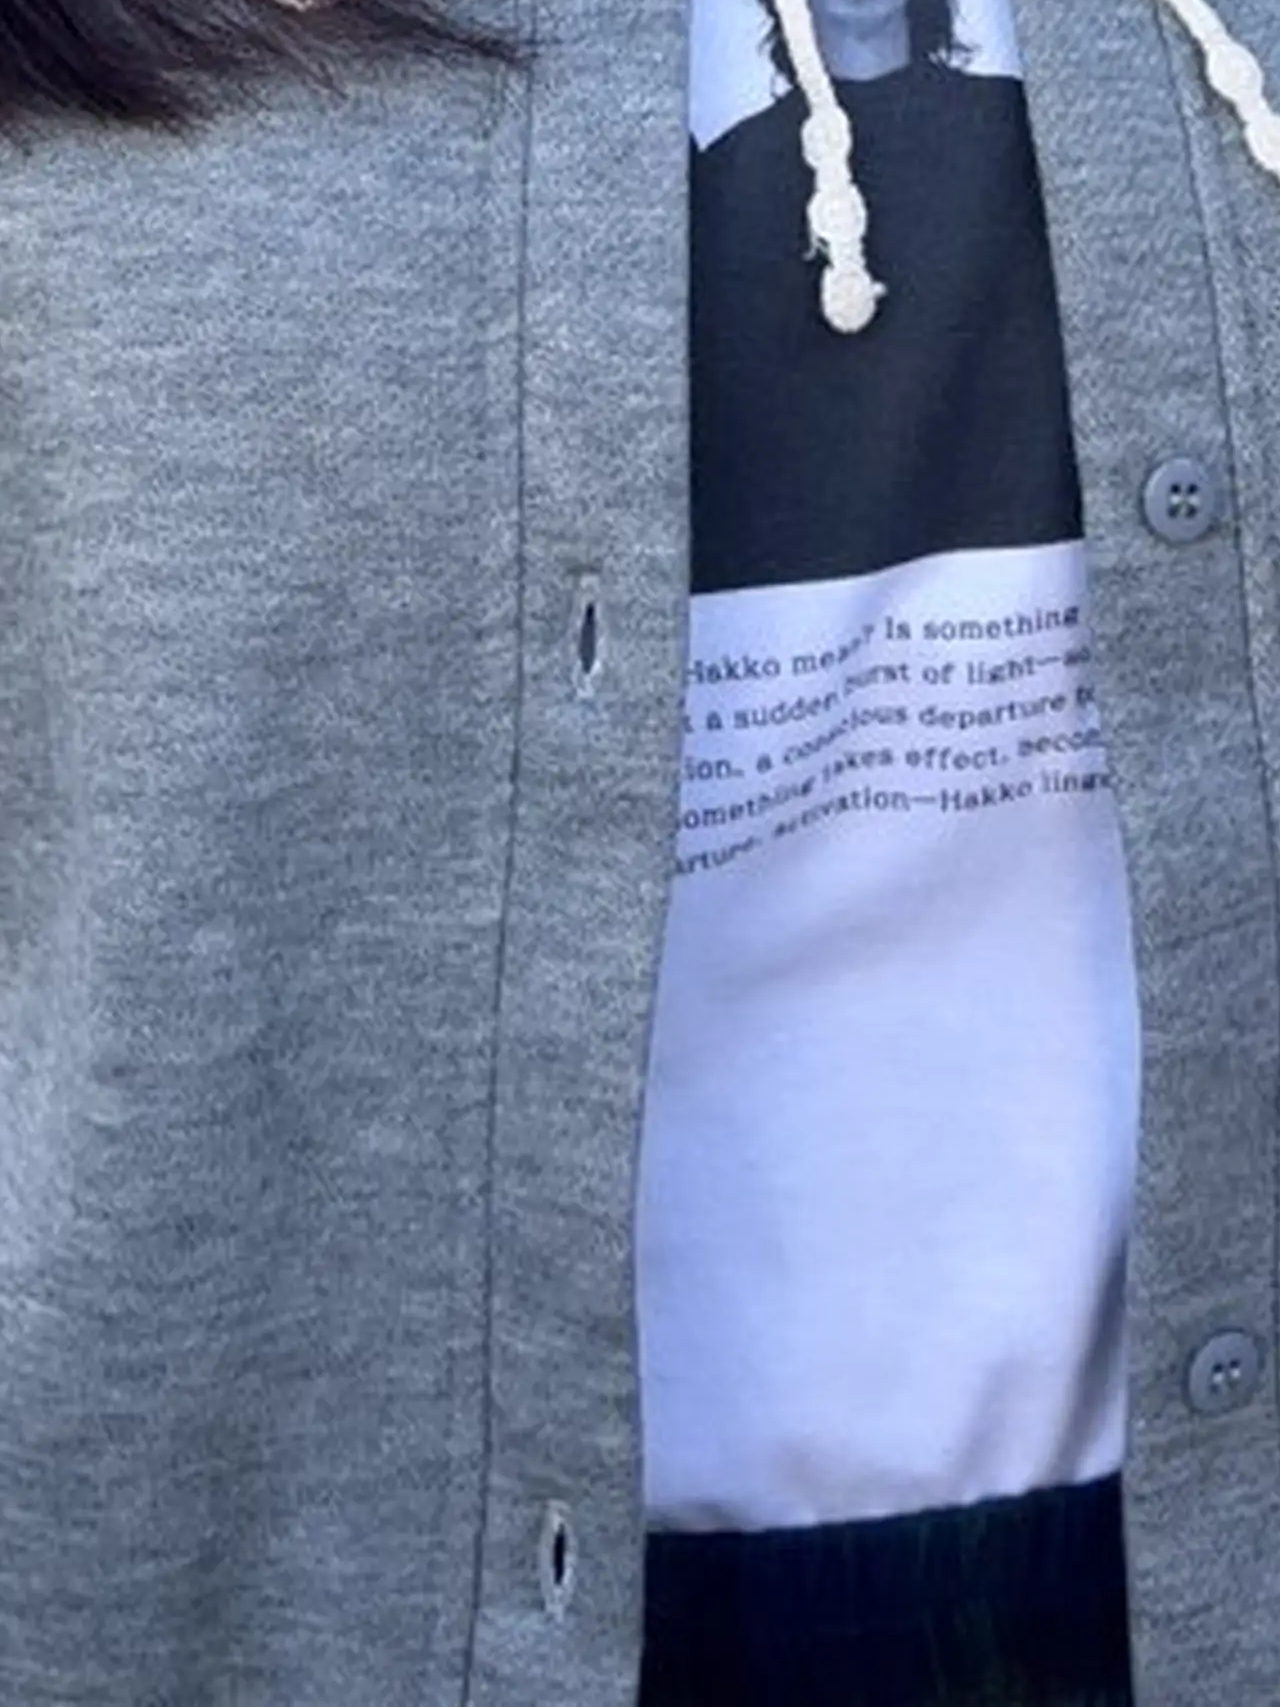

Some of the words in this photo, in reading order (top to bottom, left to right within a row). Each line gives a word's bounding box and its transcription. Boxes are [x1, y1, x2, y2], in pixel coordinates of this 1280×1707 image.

[922, 605, 1080, 642] something
[922, 660, 955, 685] of
[918, 693, 1067, 731] departure
[677, 775, 817, 830] omething
